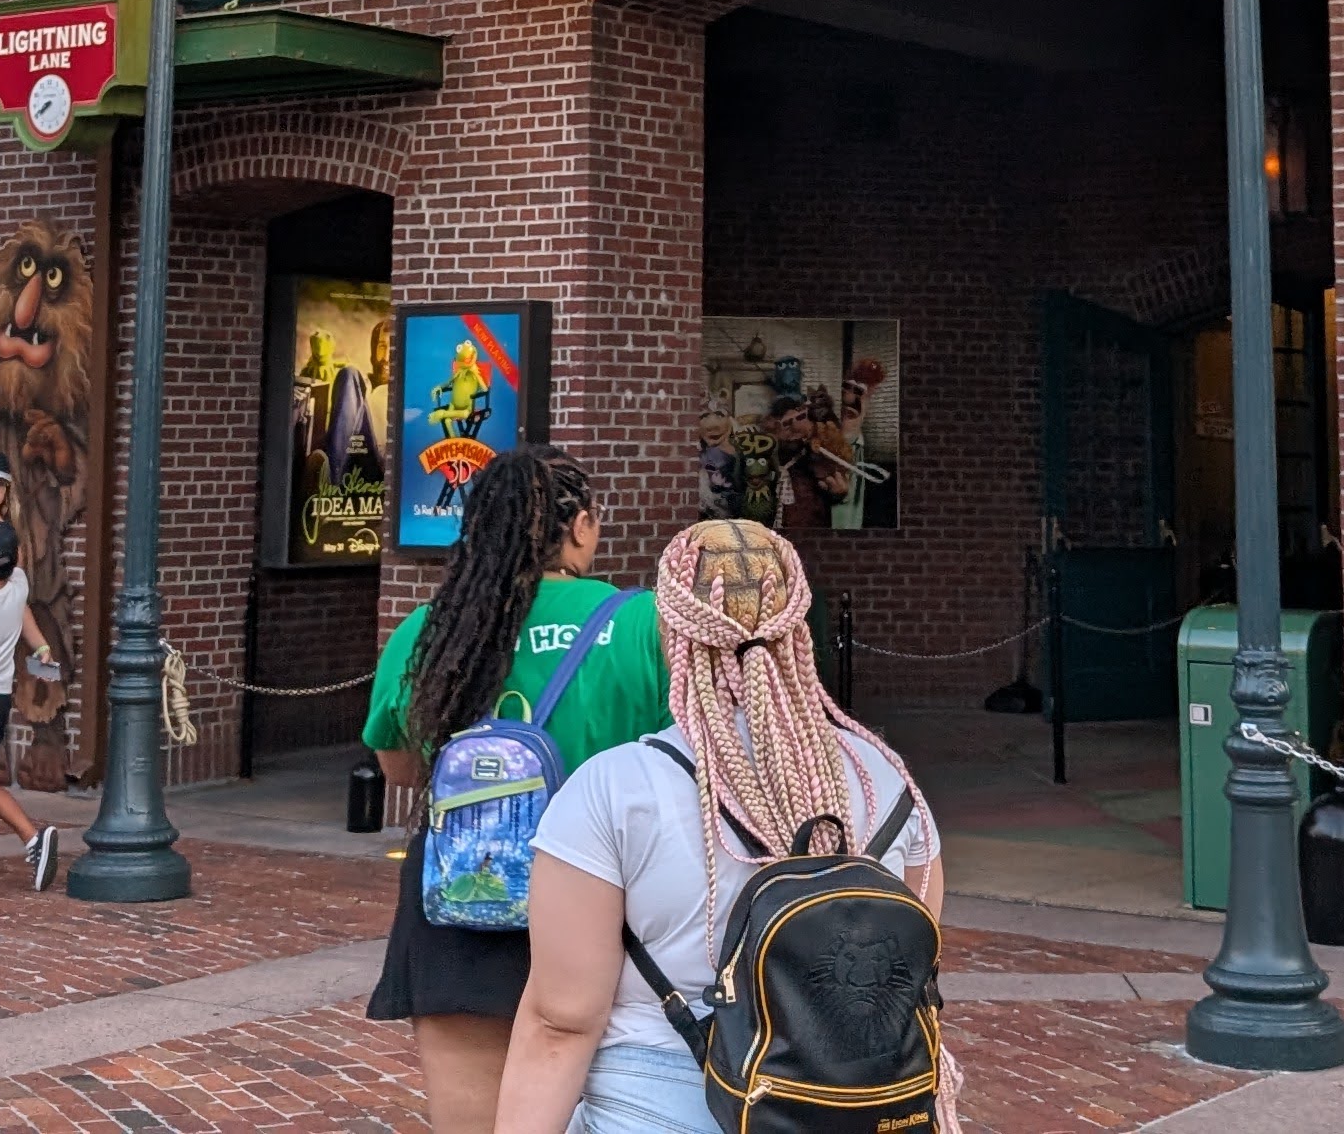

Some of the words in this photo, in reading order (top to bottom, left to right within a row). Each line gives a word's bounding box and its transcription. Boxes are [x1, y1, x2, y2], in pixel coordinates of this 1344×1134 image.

[29, 51, 71, 72] LANE
[448, 459, 472, 483] 3D
[311, 497, 355, 516] IDEA
[358, 496, 384, 515] MA
